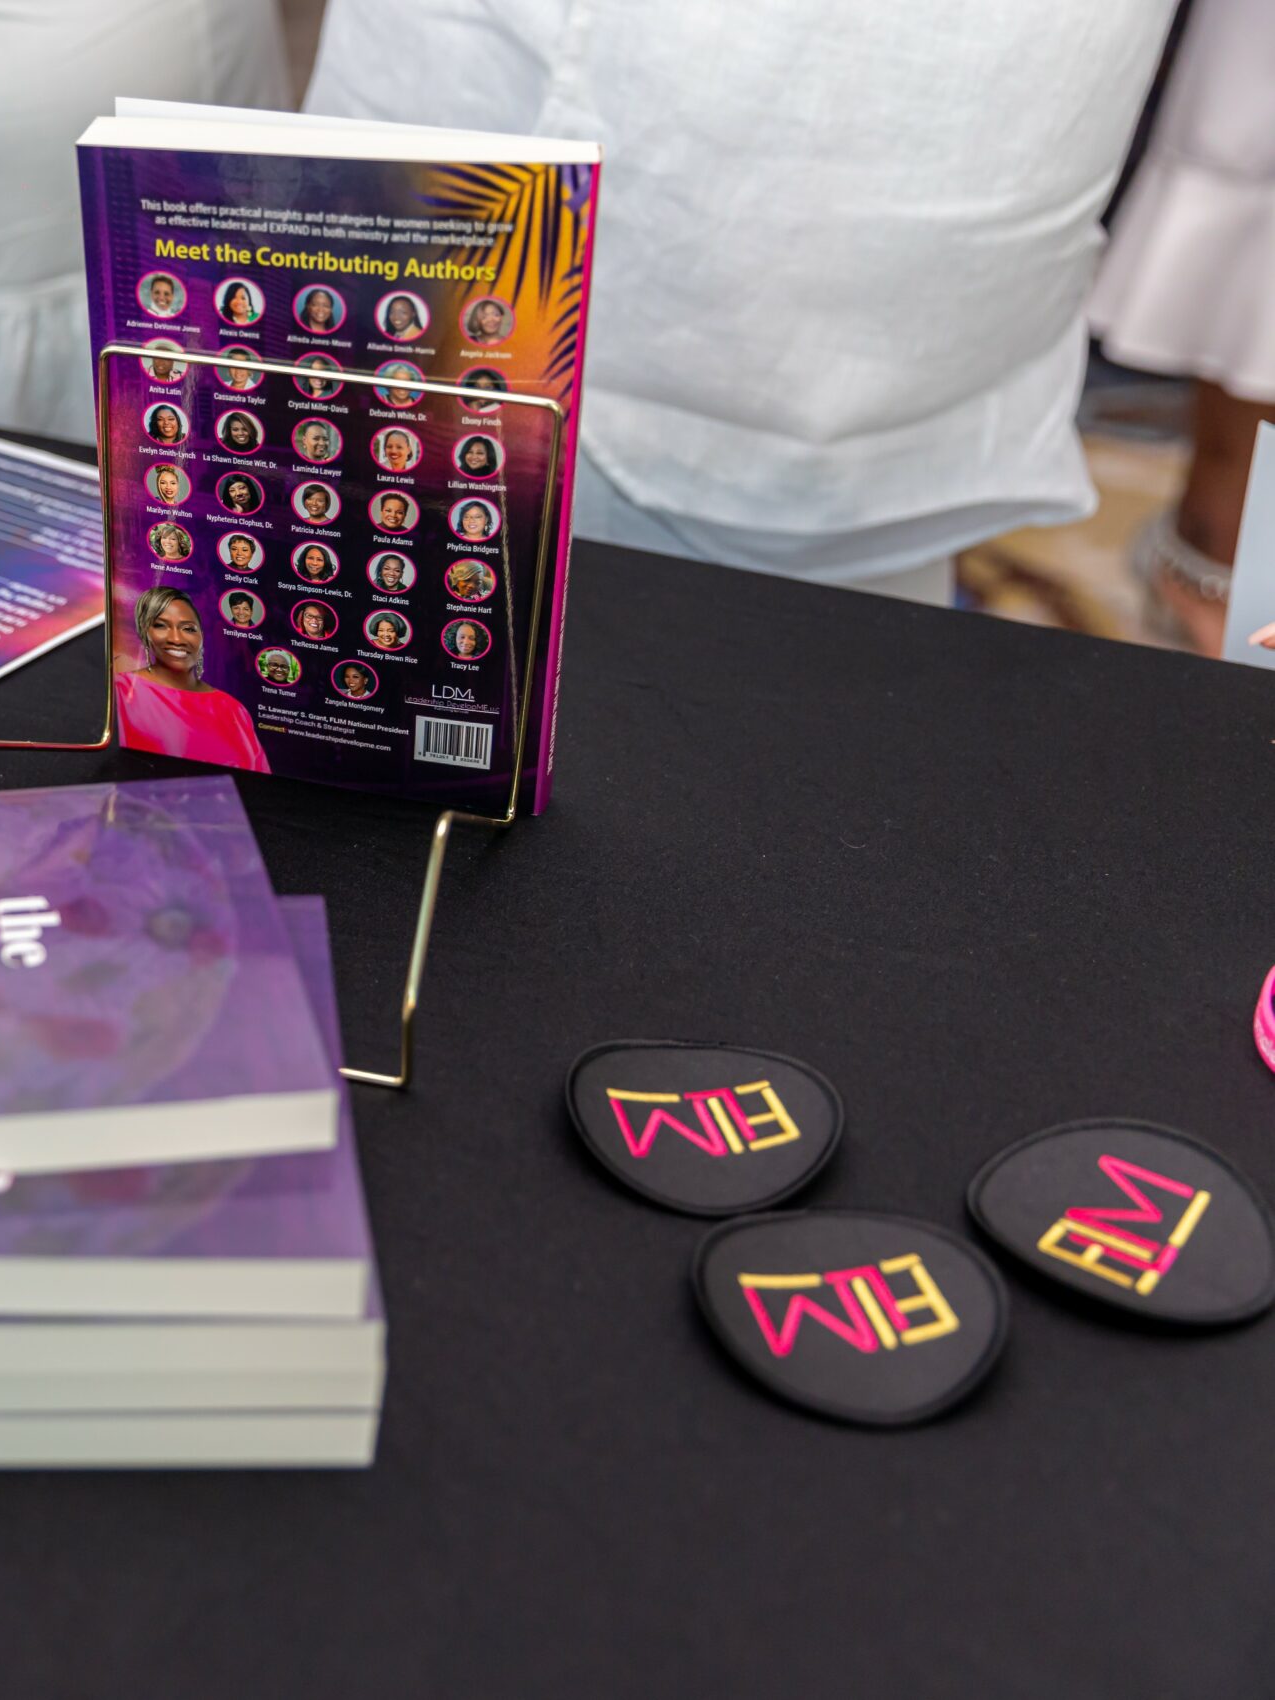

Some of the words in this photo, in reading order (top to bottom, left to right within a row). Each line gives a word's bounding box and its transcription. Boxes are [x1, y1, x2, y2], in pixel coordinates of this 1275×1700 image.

[140, 199, 161, 211] This
[162, 200, 186, 212] book
[188, 203, 217, 215] offers
[218, 205, 261, 219] practical
[263, 208, 302, 222] insights
[304, 211, 323, 223] and
[325, 212, 374, 227] strategies
[376, 215, 391, 227] for
[393, 217, 430, 229] women
[432, 218, 472, 232] seeking
[473, 221, 485, 232] to
[155, 215, 166, 225] as
[168, 214, 209, 228] effective
[211, 218, 246, 230] leaders
[248, 221, 266, 232] and
[269, 222, 309, 235] EXPAND
[311, 225, 320, 236] in
[323, 227, 346, 238] both
[348, 228, 389, 243] ministry
[391, 231, 410, 242] and
[412, 232, 428, 243] the
[430, 233, 494, 248] marketplace
[154, 238, 210, 260] Meet
[214, 242, 251, 264] the
[255, 246, 399, 281] Contributing
[403, 257, 496, 283] Authors
[148, 385, 165, 394] Anita
[165, 387, 181, 396] Latin
[213, 392, 245, 402] Cassandra
[247, 395, 265, 405] Taylor
[288, 399, 309, 410] Crystal
[310, 402, 348, 413] Miller-Davis
[369, 408, 396, 418] Deborah
[461, 416, 481, 426] Ebony
[482, 417, 501, 426] Finch
[138, 445, 157, 455] Evelyn
[202, 453, 210, 461] La
[211, 454, 231, 463] Shawn
[232, 457, 253, 466] Denise
[376, 473, 395, 482] Laura
[396, 475, 414, 485] Lewis
[468, 481, 506, 494] Washington
[291, 524, 314, 534] Patricia
[314, 527, 340, 537] Johnson
[373, 534, 390, 543] Paula
[391, 536, 413, 546] Adams
[472, 544, 499, 555] Bridgers
[165, 565, 192, 575] Anderson
[224, 573, 241, 583] Shelly
[242, 576, 258, 584] Clark
[277, 581, 295, 591] Sonya
[344, 590, 352, 598] Dr.
[372, 594, 387, 602] Staci
[388, 596, 408, 605] Adkins
[446, 602, 476, 614] Stephanie
[477, 606, 492, 614] Hart
[247, 632, 263, 640] Cook
[319, 643, 338, 653] James
[356, 649, 383, 660] Thursday
[384, 653, 403, 662] Brown
[404, 656, 417, 664] Rice
[450, 661, 466, 671] Tracy
[467, 663, 479, 671] Lee
[404, 693, 445, 707] Leadership
[348, 701, 384, 714] Montgomery
[257, 712, 293, 724] Leadership
[294, 718, 315, 727] Coach
[323, 723, 355, 735] Strategist
[308, 713, 328, 722] Grant,
[329, 716, 346, 725] FLIM
[347, 719, 375, 730] National
[376, 724, 409, 735] President
